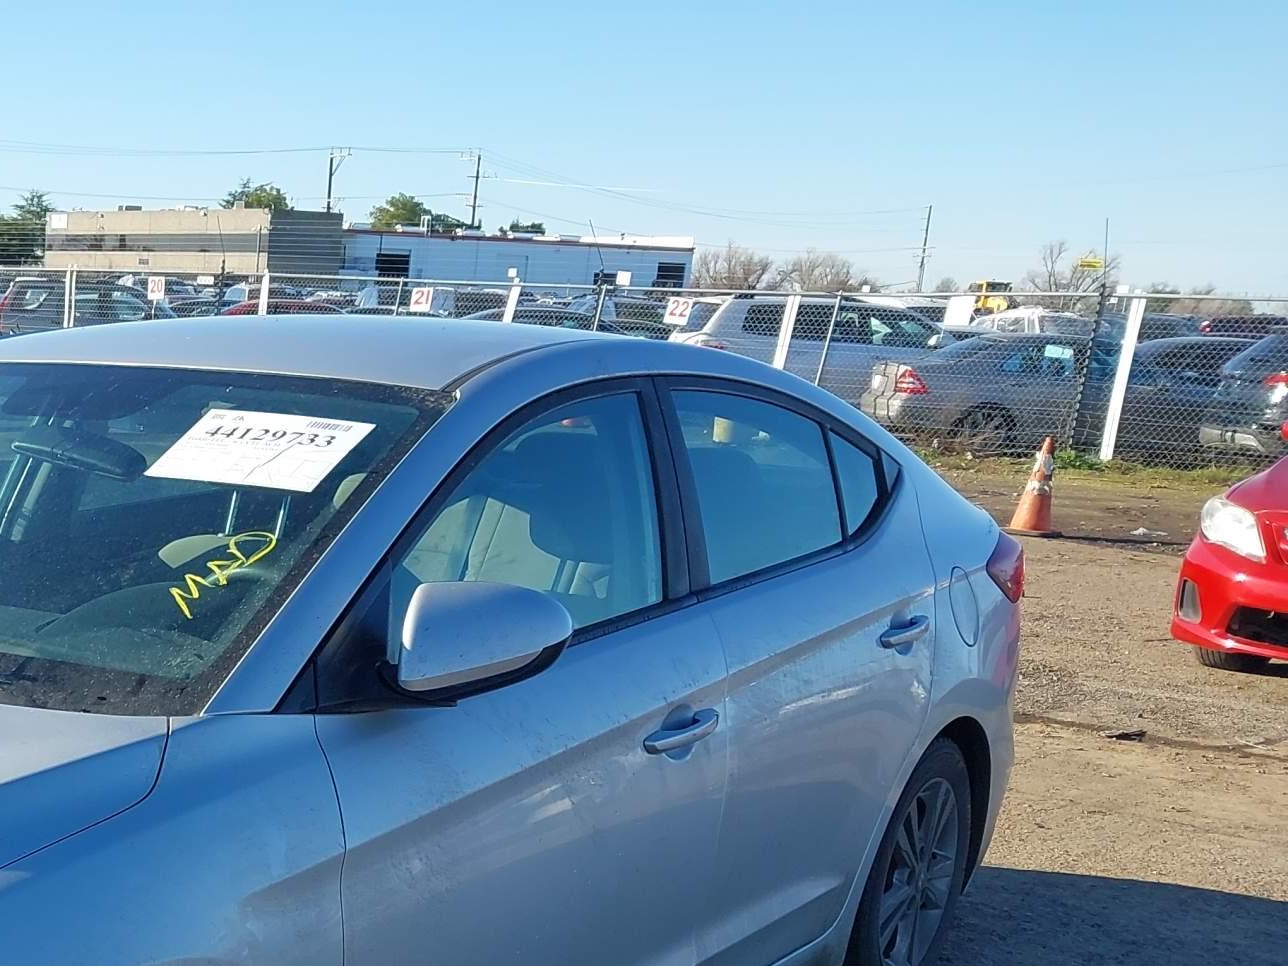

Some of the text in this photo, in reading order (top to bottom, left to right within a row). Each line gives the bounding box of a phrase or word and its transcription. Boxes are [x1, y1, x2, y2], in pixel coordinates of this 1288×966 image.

[150, 278, 163, 293] 20
[413, 289, 430, 305] 21
[668, 299, 690, 317] 22
[205, 425, 337, 448] 44129733
